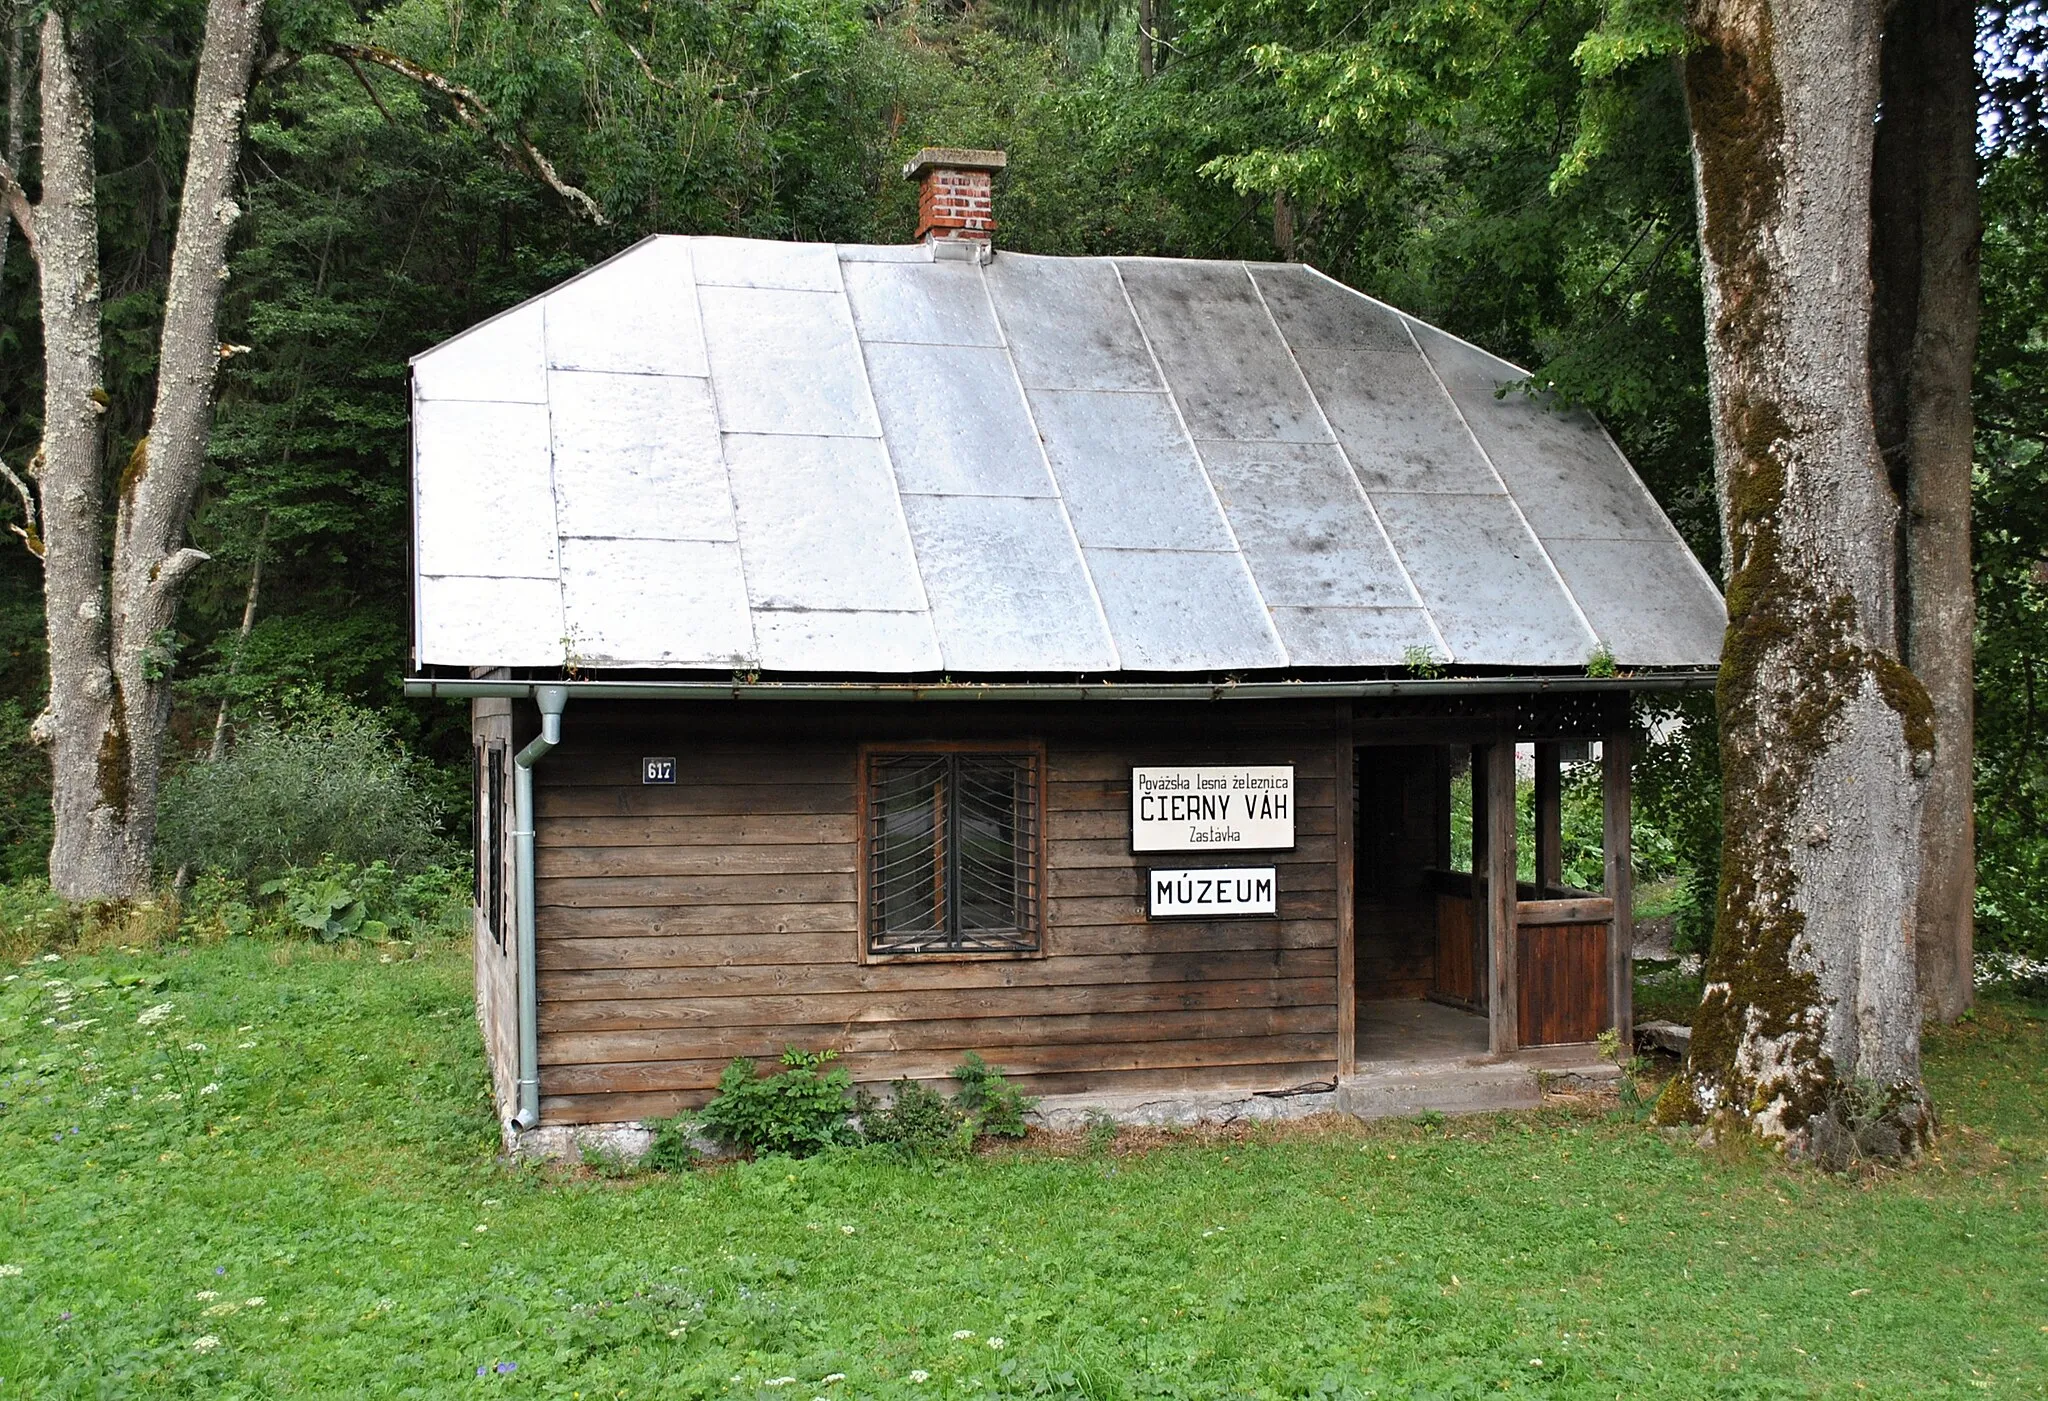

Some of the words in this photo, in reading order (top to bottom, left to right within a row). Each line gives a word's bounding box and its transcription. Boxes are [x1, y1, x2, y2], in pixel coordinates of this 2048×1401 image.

[648, 762, 671, 779] 617
[1197, 773, 1227, 790] lesná
[1232, 773, 1289, 789] železnica
[1140, 791, 1230, 821] ČIERNY
[1245, 790, 1287, 820] VÁH
[1189, 825, 1240, 842] Zastávka
[1157, 873, 1271, 905] MÚZEUM
